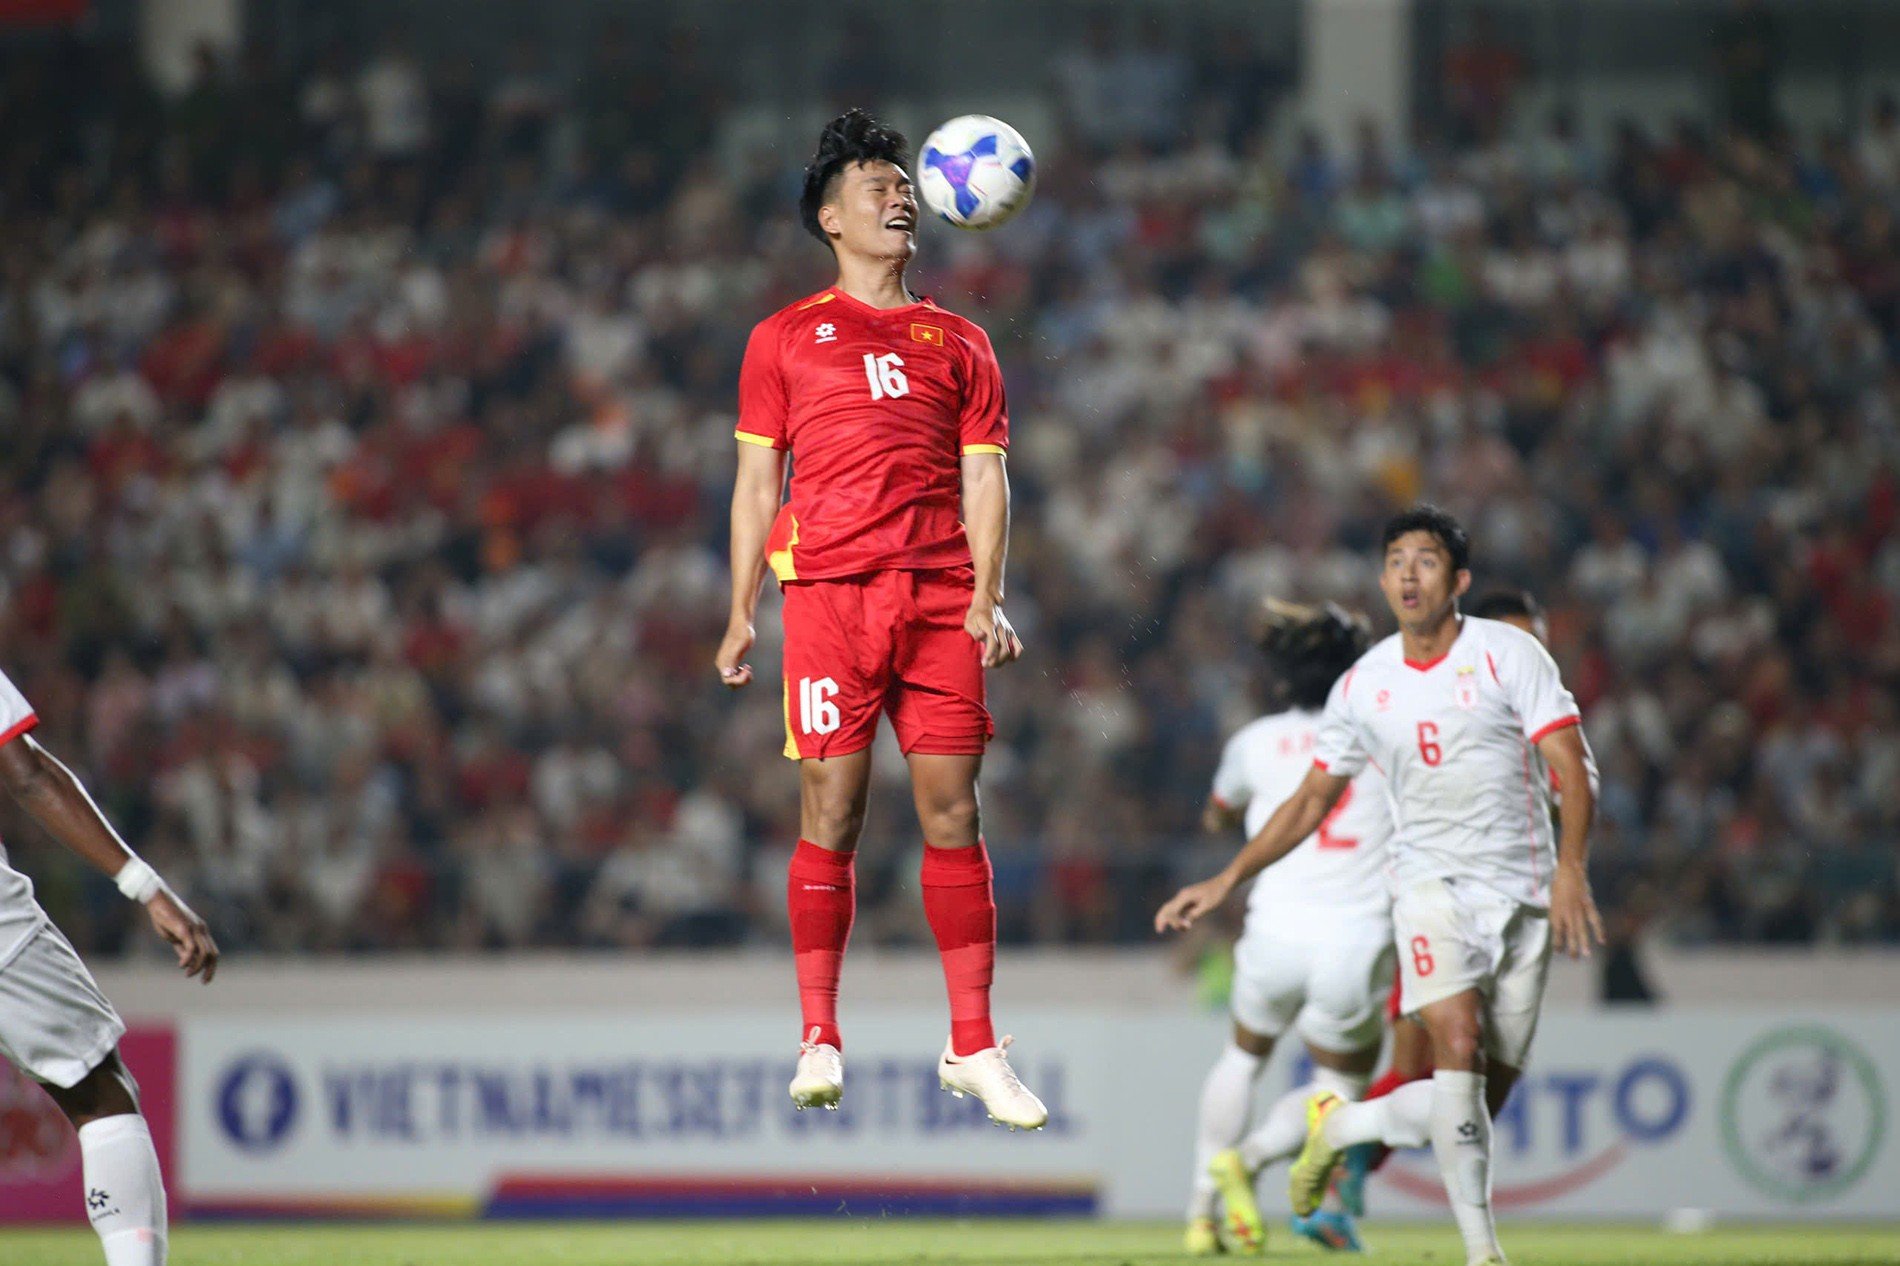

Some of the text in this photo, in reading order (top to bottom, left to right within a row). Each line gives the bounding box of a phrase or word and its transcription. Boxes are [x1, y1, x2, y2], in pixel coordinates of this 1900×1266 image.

[863, 352, 909, 401] 16
[799, 676, 840, 735] 16
[1416, 721, 1442, 766] 6
[1410, 936, 1434, 977] 6
[323, 1062, 1086, 1138] VIETNAMESEFTBL
